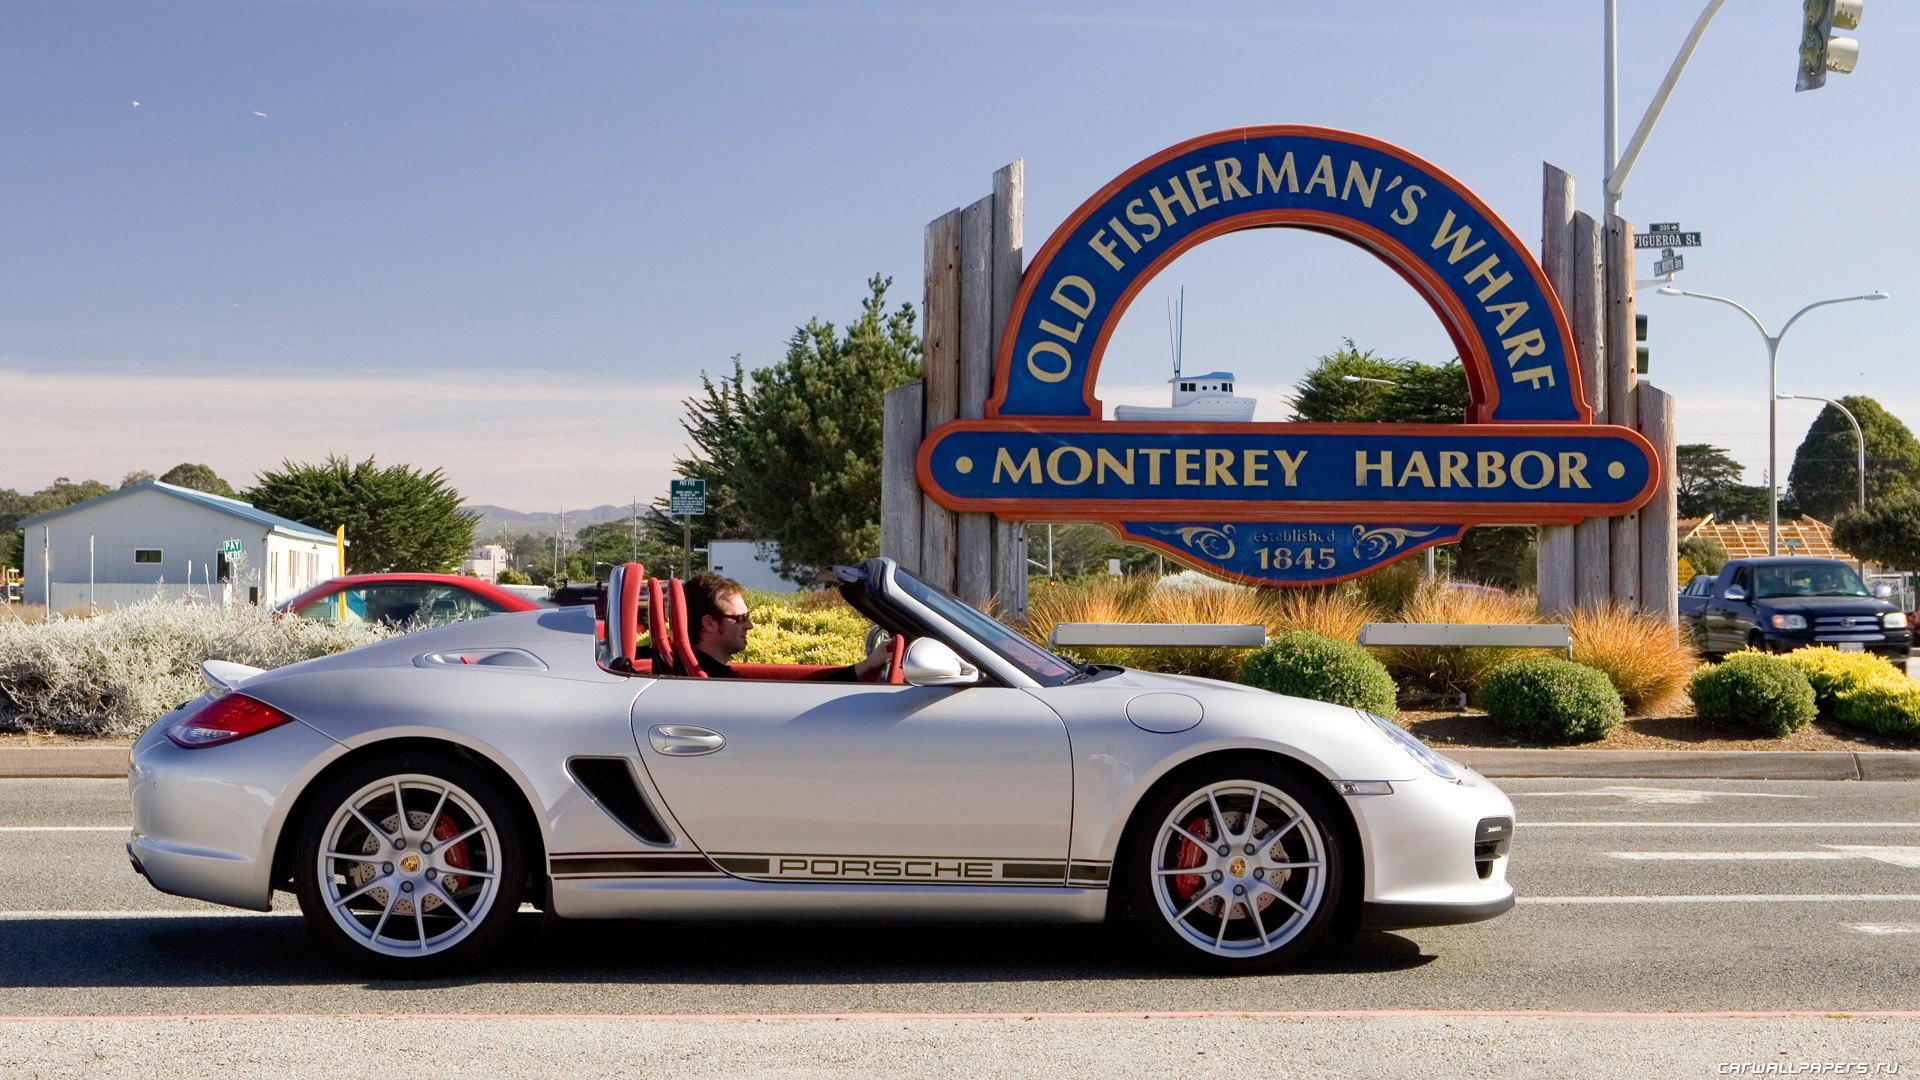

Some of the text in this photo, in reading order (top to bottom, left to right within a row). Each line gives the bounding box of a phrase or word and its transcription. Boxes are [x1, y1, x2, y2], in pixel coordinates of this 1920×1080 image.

[1634, 234, 1699, 247] FIGUEROA St.
[1027, 151, 1556, 390] OLD FISHERMAN'S WHARF
[992, 447, 1592, 489] MONTEREY HARBOR
[225, 541, 239, 550] PAY
[225, 551, 242, 561] HERE
[1253, 547, 1336, 570] 1845
[779, 858, 993, 878] PORSCHE
